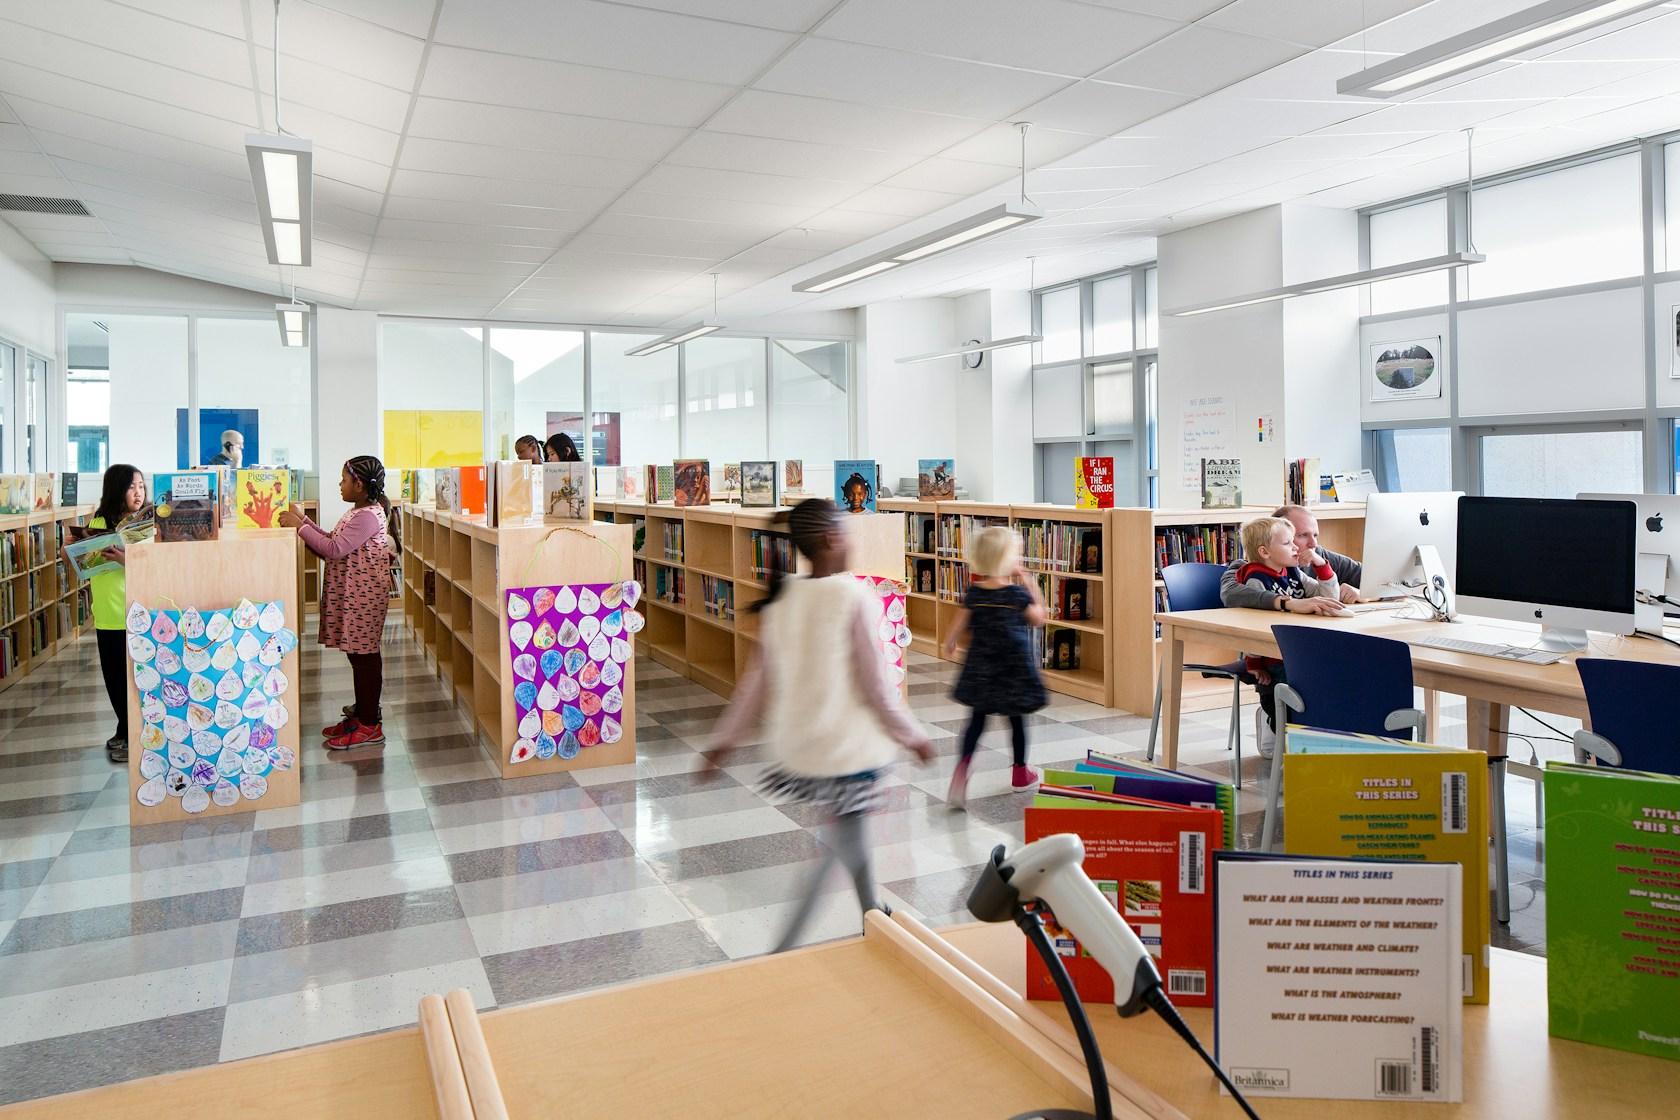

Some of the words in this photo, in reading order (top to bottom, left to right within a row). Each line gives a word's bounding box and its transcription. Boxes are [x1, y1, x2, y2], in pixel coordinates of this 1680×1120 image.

[1090, 459, 1097, 467] IF
[1093, 467, 1107, 475] RAN
[1090, 476, 1103, 484] THE
[1090, 484, 1113, 493] CIRCUS
[1362, 778, 1398, 787] TITLES
[1400, 778, 1412, 787] IN
[1355, 791, 1380, 800] THIS
[1383, 791, 1419, 800] SERIES
[1632, 820, 1667, 832] THIS
[1293, 870, 1323, 879] TITLES
[1325, 870, 1336, 879] IN
[1339, 870, 1359, 879] THIS
[1362, 871, 1393, 880] SERIES
[1269, 895, 1286, 903] ARE
[1288, 895, 1303, 903] AIR
[1306, 896, 1339, 904] MASSES
[1342, 896, 1361, 904] AND
[1363, 897, 1403, 905] WEATHER
[1405, 897, 1444, 906] FRONTS?
[1248, 918, 1273, 926] WHAT
[1275, 918, 1292, 927] ARE
[1295, 919, 1311, 927] THE
[1313, 919, 1357, 928] ELEMENTS
[1360, 920, 1372, 928] OF
[1393, 921, 1438, 930] WEATHER?
[1267, 942, 1292, 950] WHAT
[1294, 942, 1310, 950] ARE
[1313, 943, 1353, 951] WEATHER
[1356, 944, 1375, 952] AND
[1377, 945, 1419, 953] CLIMATE?
[1266, 965, 1291, 973] WHAT
[1293, 966, 1310, 974] ARE
[1313, 967, 1353, 975] WEATHER
[1355, 968, 1420, 977] INSTRUMENTS?
[1284, 989, 1308, 997] WHAT
[1311, 989, 1319, 998] IS
[1321, 990, 1337, 998] THE
[1340, 991, 1402, 1000] ATMOSPHERE?
[1271, 1013, 1296, 1021] WHAT
[1298, 1013, 1306, 1021] IS
[1308, 1013, 1348, 1022] WEATHER
[1351, 1015, 1415, 1024] FORECASTING?
[1235, 1075, 1284, 1086] Britannica
